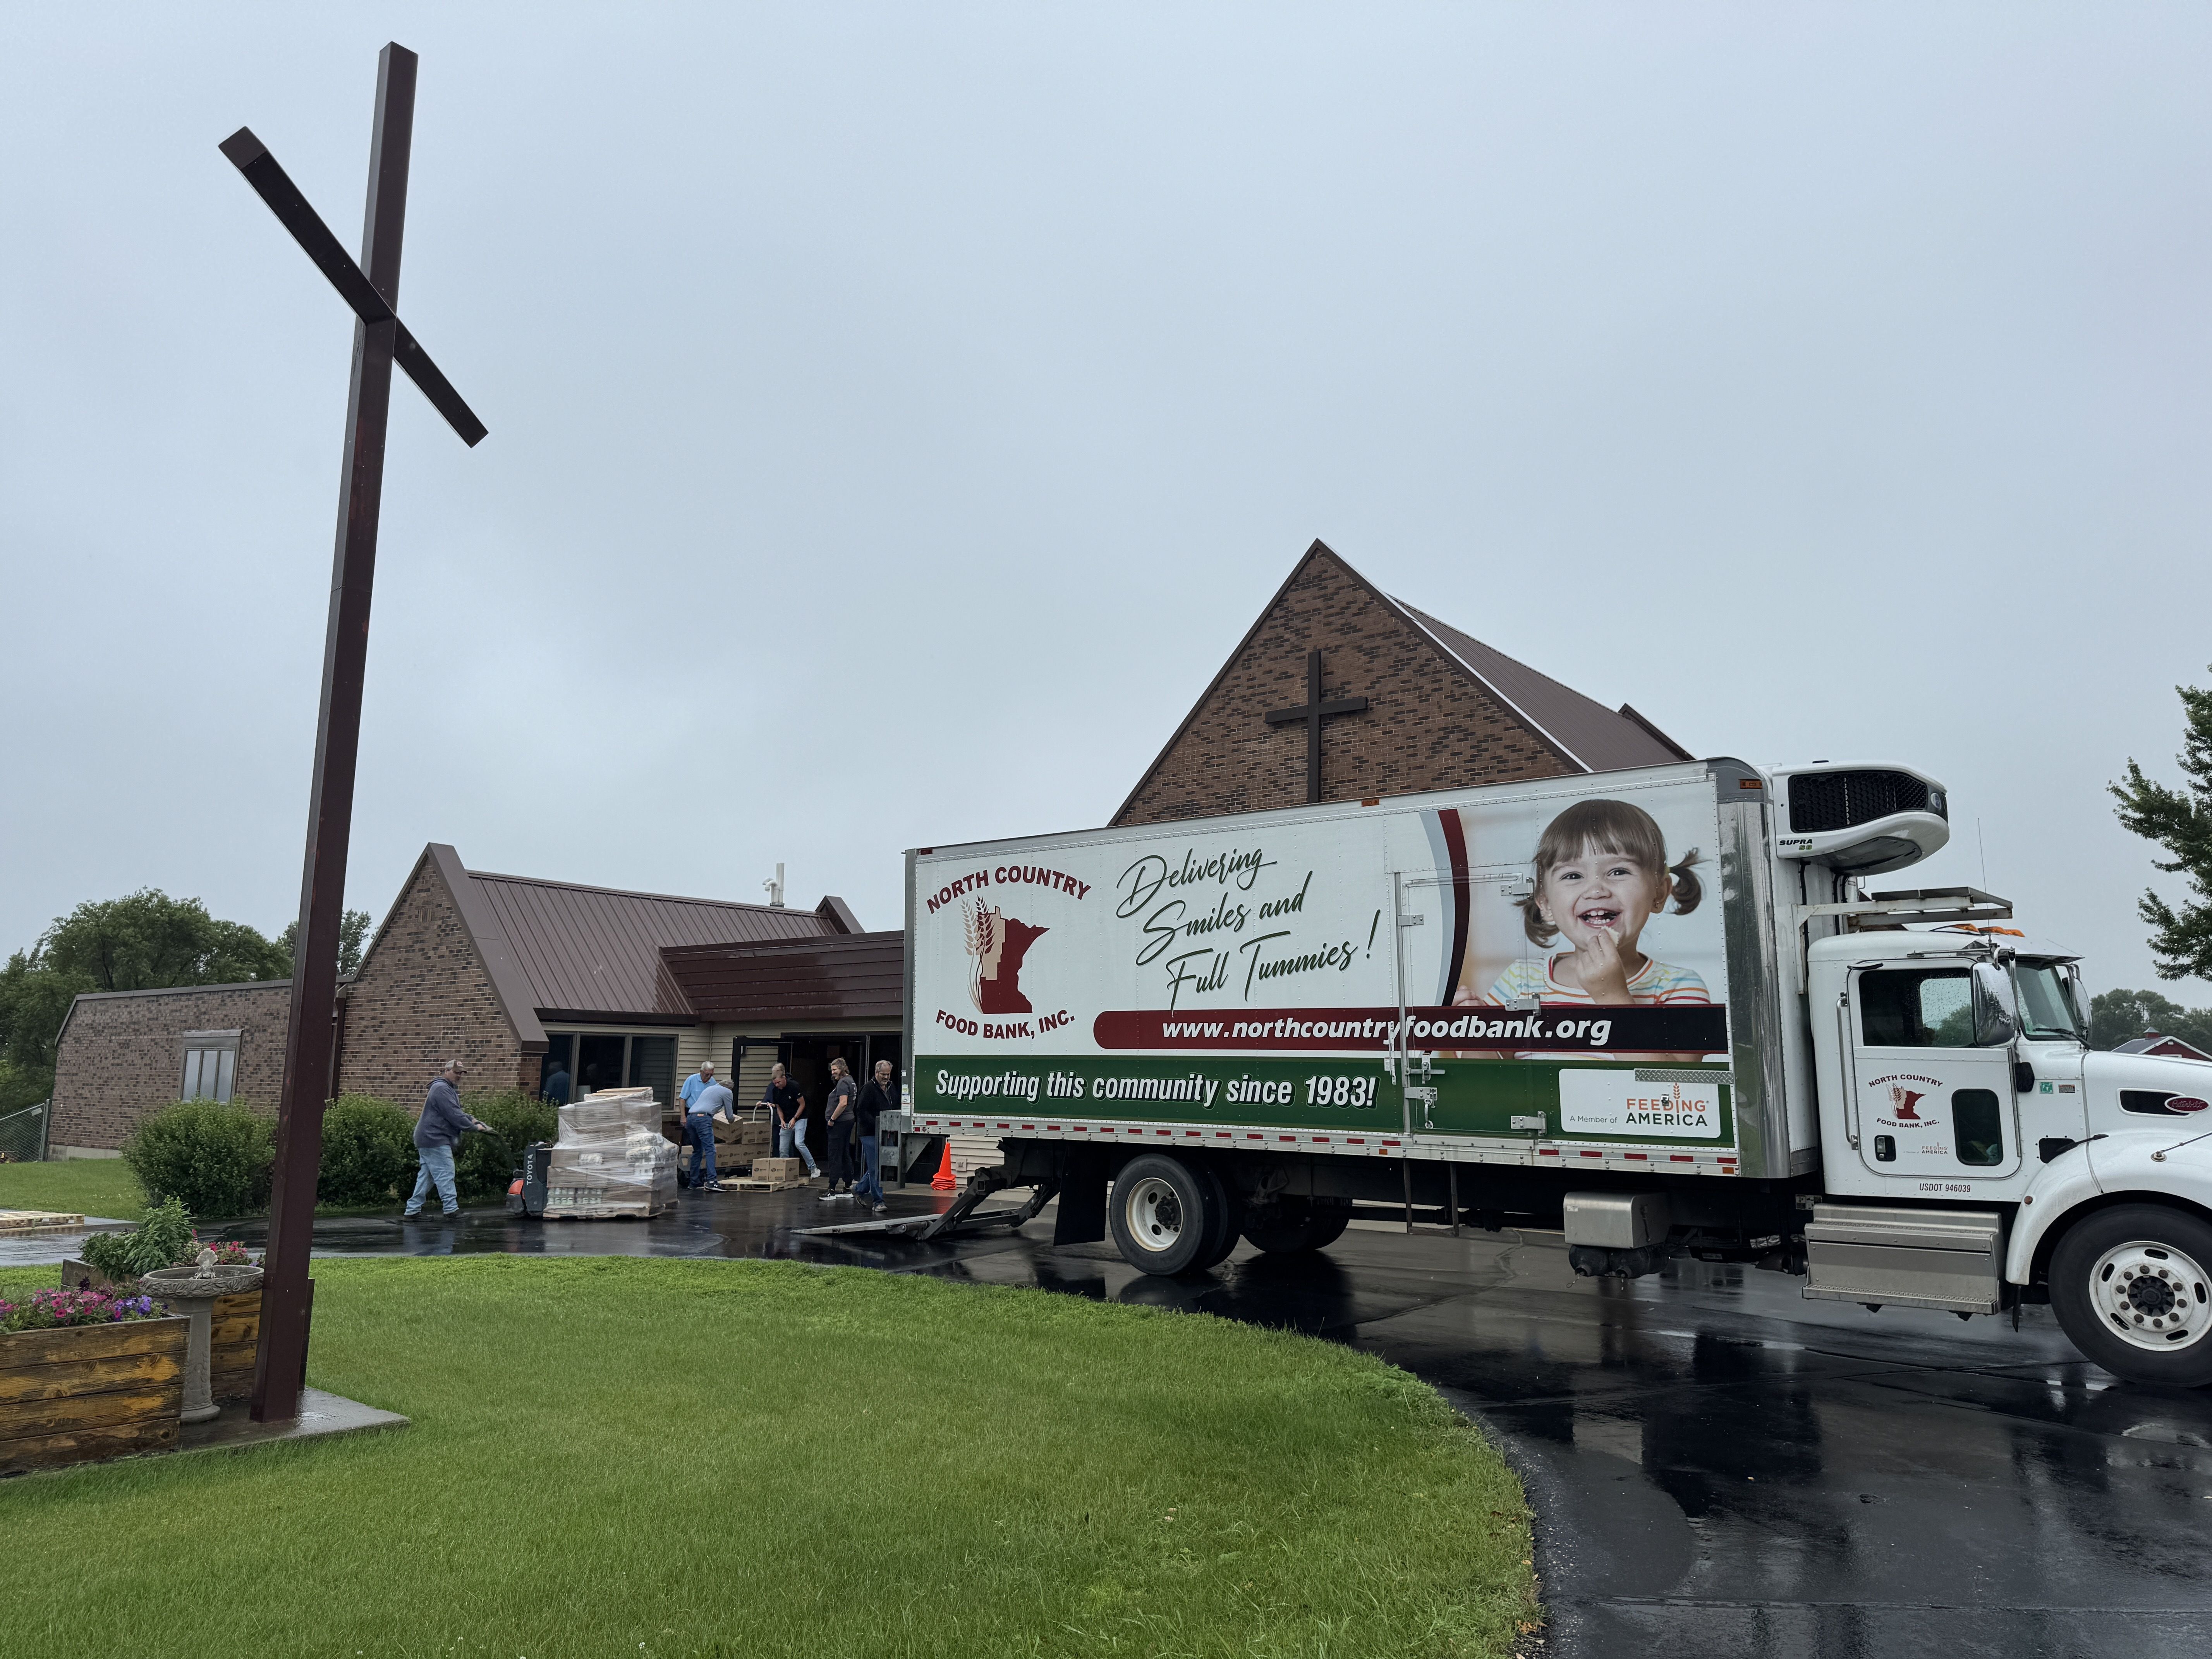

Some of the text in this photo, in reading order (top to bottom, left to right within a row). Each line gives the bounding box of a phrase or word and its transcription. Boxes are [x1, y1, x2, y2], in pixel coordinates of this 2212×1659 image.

[927, 866, 1092, 914] NORTH COUNTRY
[1116, 848, 1278, 918] Delivering
[1136, 870, 1313, 966] Smiles and
[1166, 948, 1229, 1018] Full
[936, 1009, 1075, 1039] FOOD BANK, INC.
[1163, 1015, 1612, 1046] www.northcountryfoodbank.org
[936, 1069, 1377, 1108] Supporting this community since 1983!
[1868, 1074, 1943, 1087] NORTH COUNTRY
[2172, 1099, 2205, 1108] Peterbilt
[1626, 1113, 1708, 1126] AMERICA
[1877, 1118, 1897, 1127] FOOD
[1919, 1183, 1971, 1192] USDOT 946039
